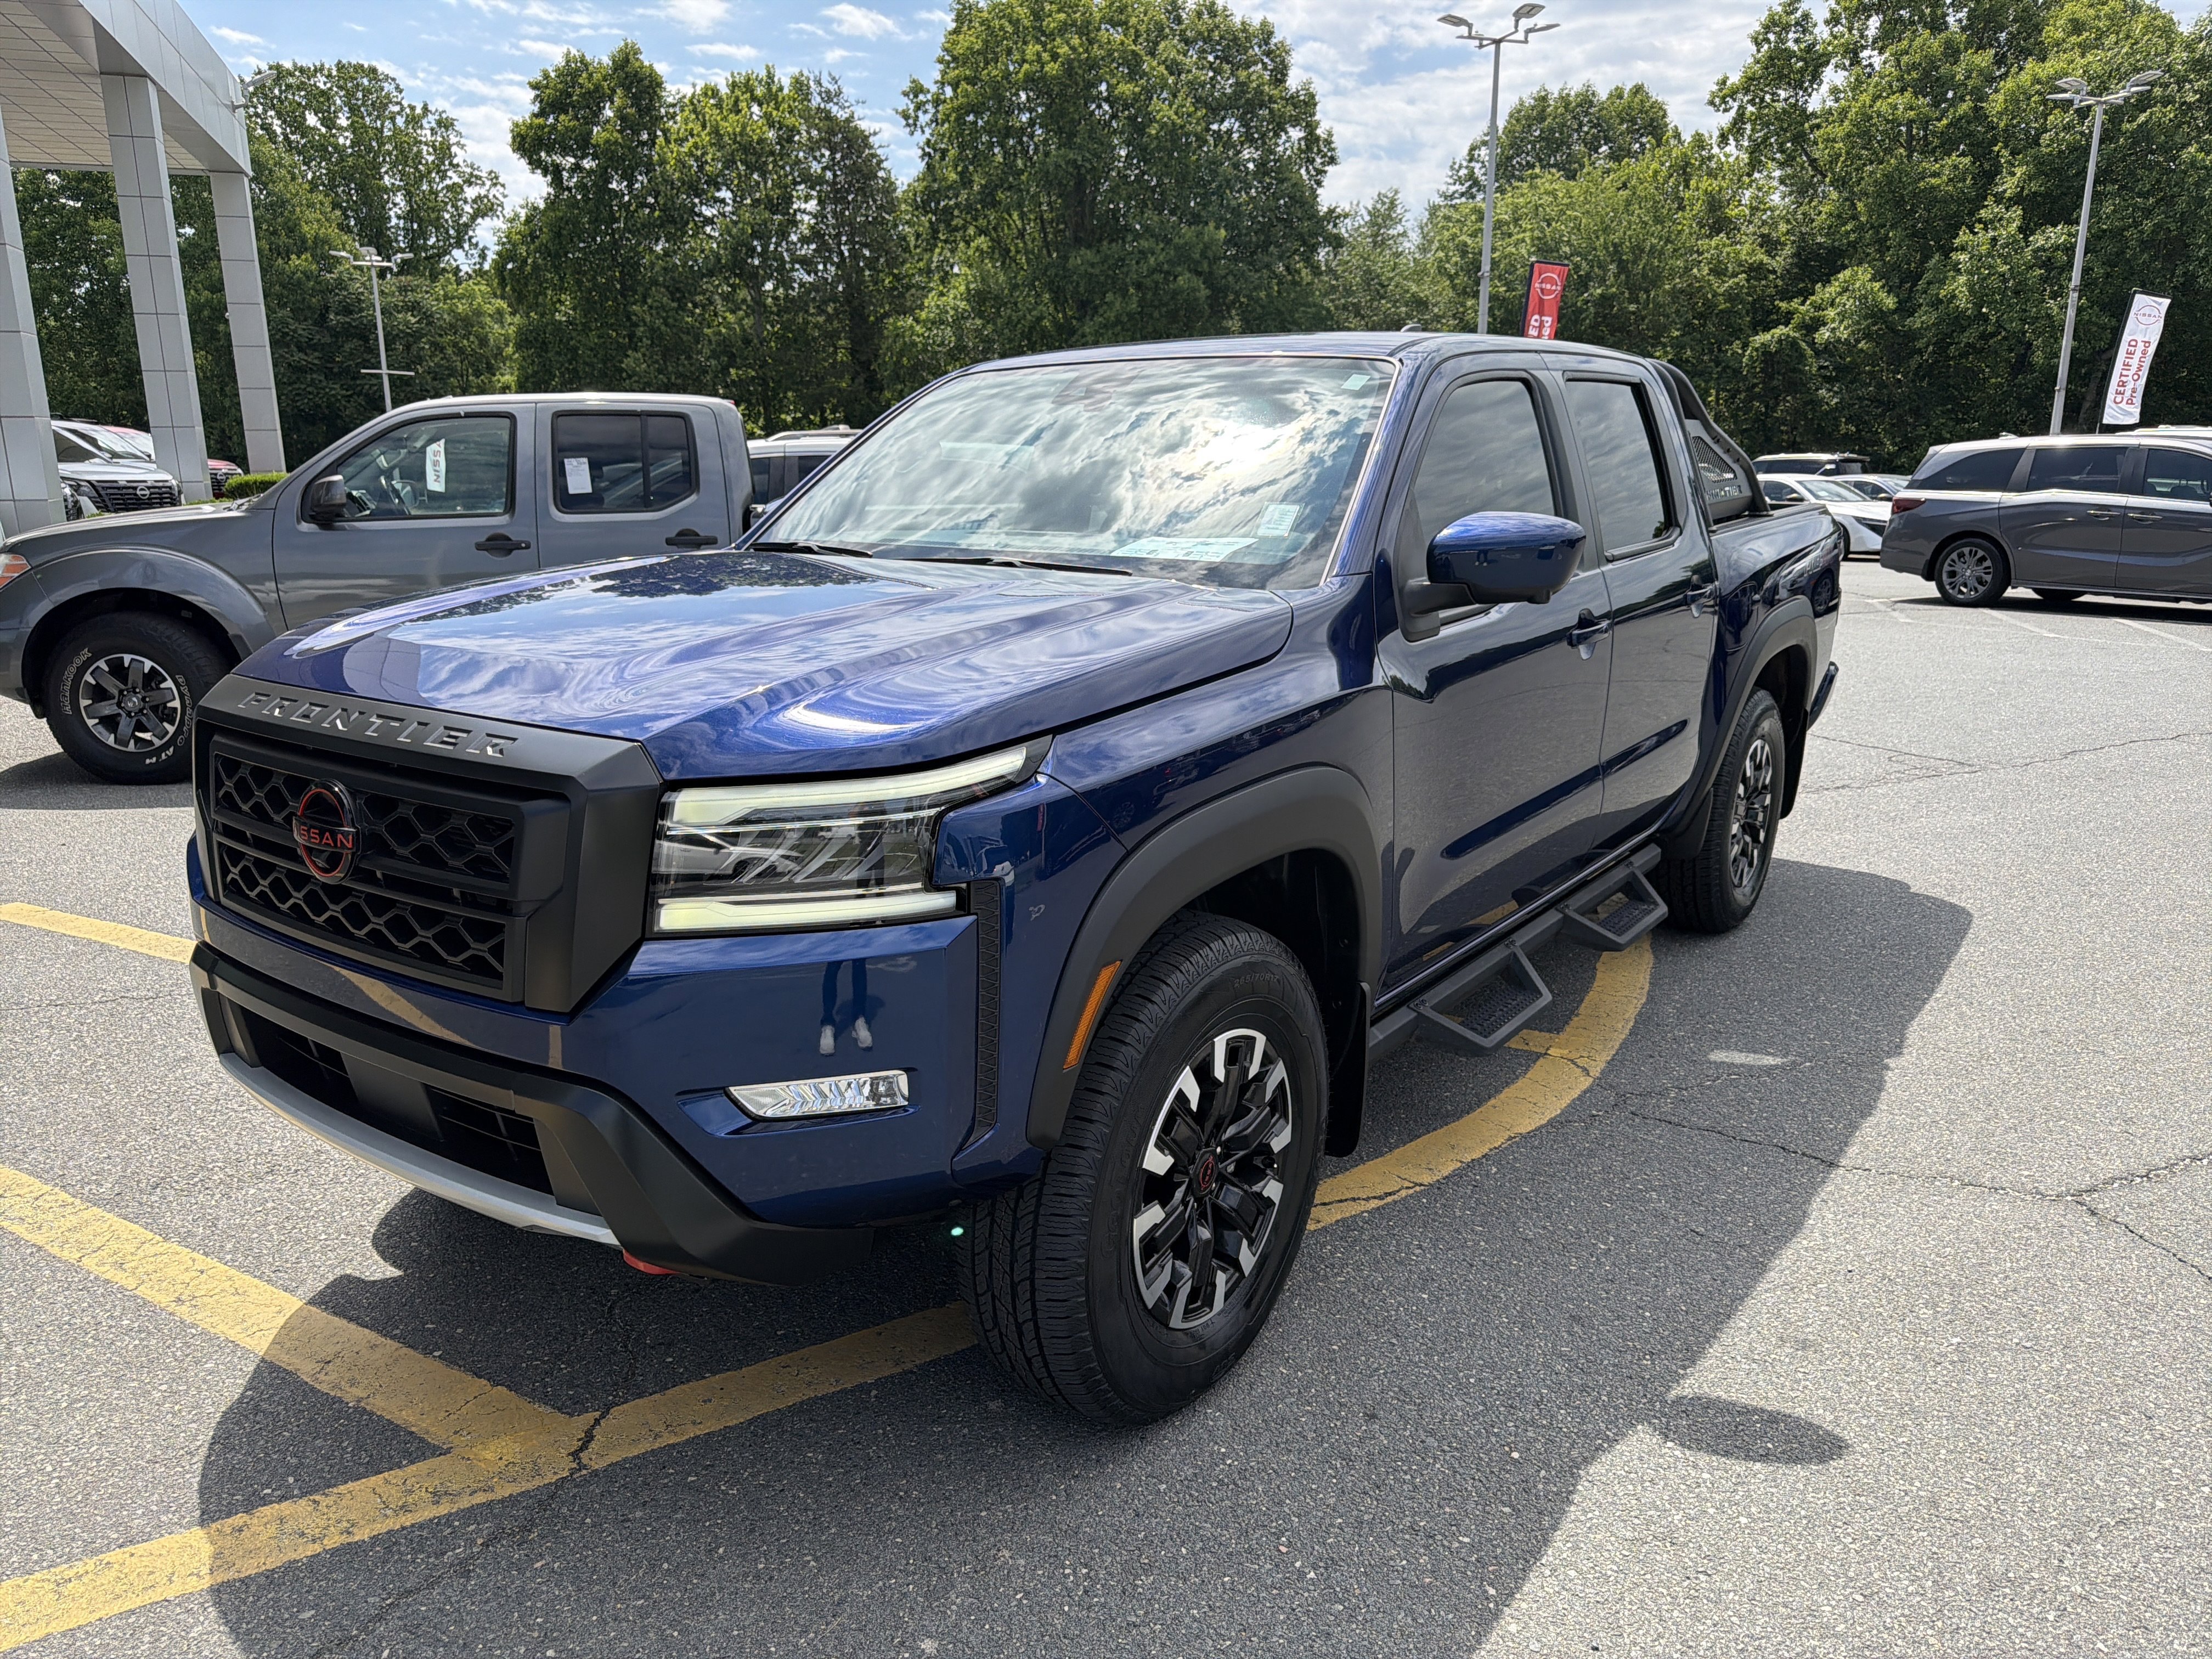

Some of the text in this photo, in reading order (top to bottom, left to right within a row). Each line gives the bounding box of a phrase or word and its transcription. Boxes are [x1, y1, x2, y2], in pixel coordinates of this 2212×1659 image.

[2113, 338, 2138, 404] CERTIFIED
[2125, 340, 2152, 405] Pre-Owned
[237, 691, 519, 758] FRONTIER
[299, 825, 353, 849] SSAN
[1234, 973, 1279, 988] 265/70R17
